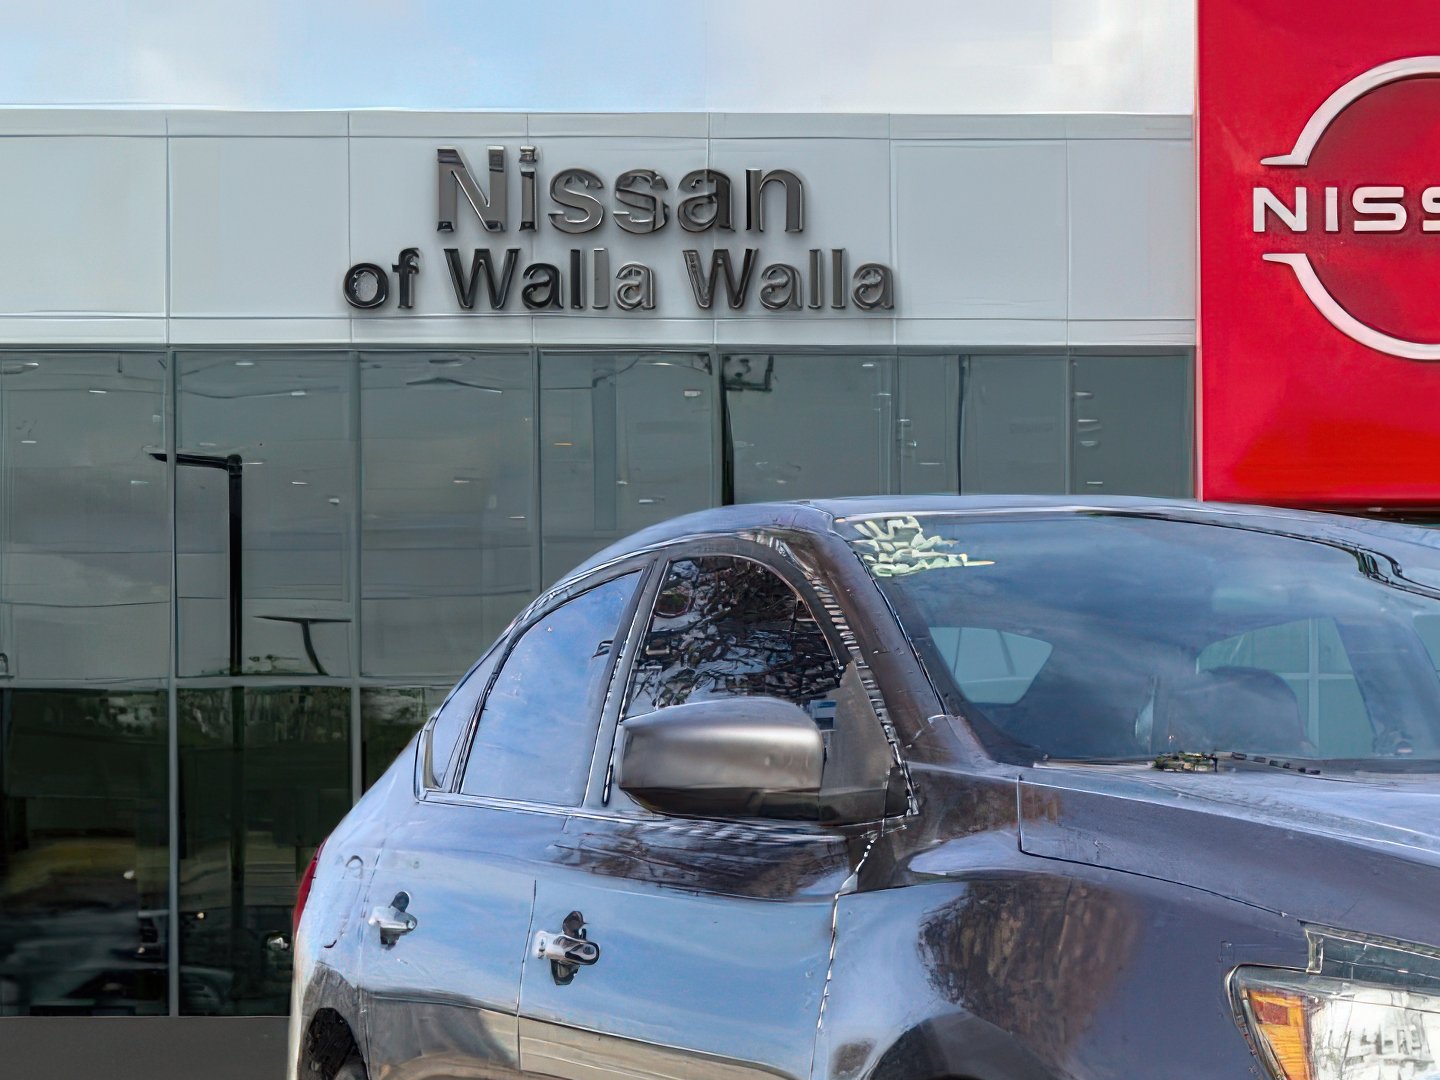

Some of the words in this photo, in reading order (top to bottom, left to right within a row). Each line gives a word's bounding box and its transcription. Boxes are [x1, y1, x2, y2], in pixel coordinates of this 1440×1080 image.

[437, 145, 805, 234] Nissan
[342, 246, 420, 310] of
[443, 248, 656, 310] Walla
[683, 248, 896, 310] Walla
